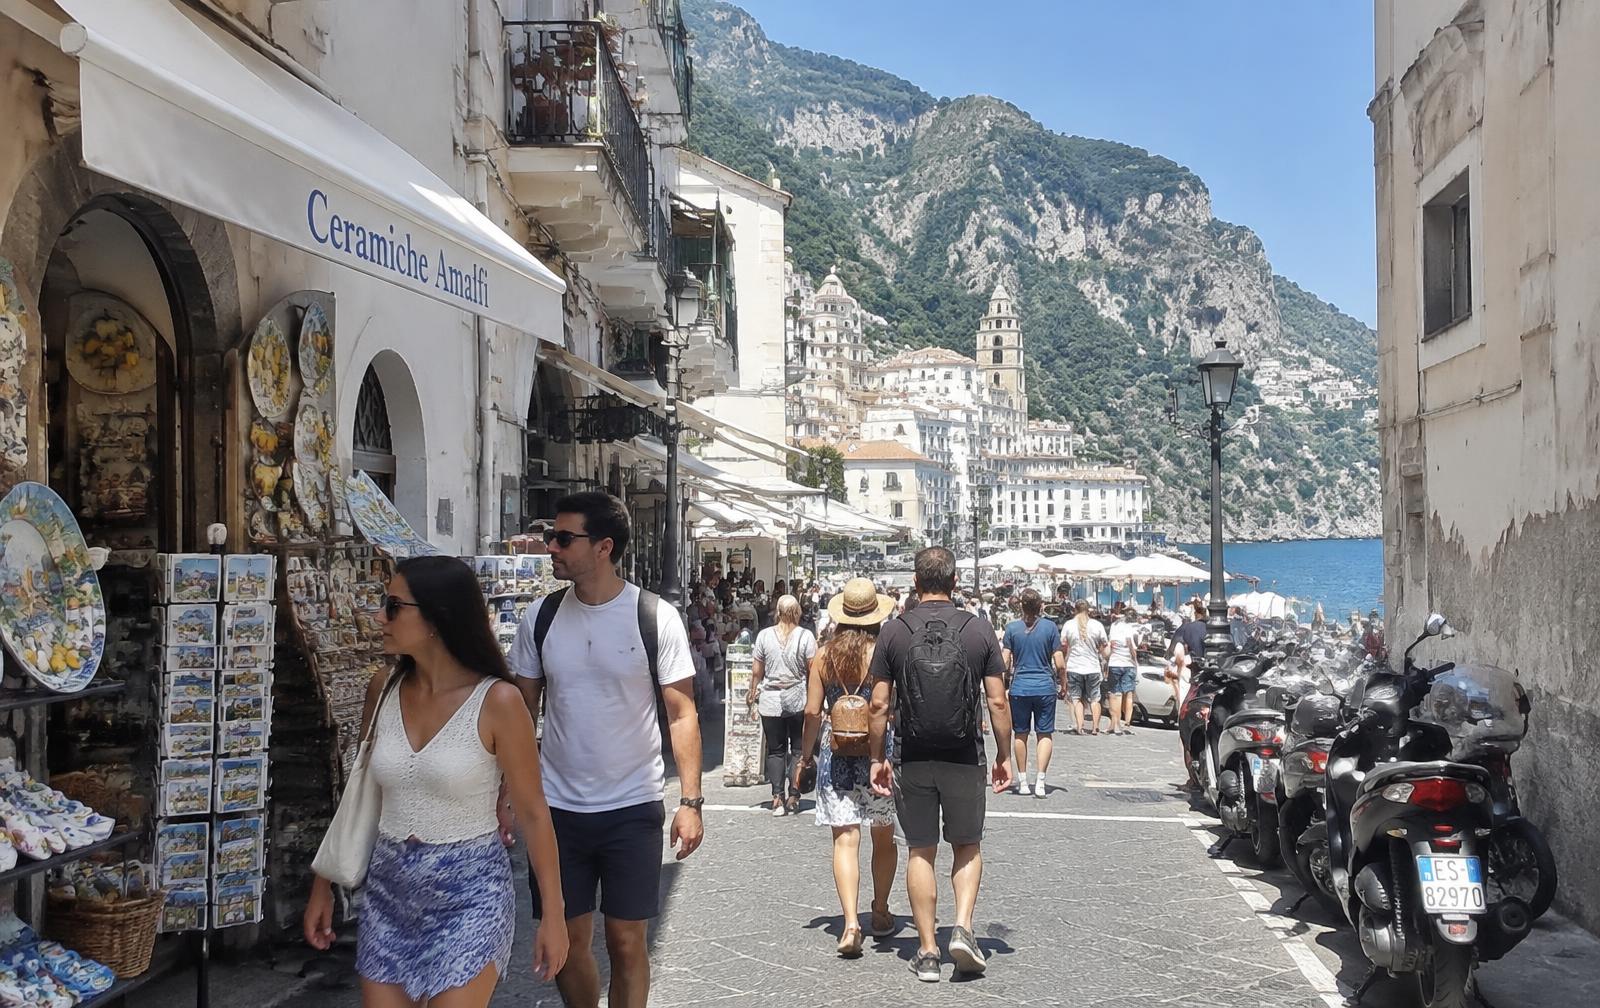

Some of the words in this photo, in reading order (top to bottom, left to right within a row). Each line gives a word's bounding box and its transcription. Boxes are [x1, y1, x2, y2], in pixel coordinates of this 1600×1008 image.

[308, 189, 429, 283] Ceramiche
[435, 249, 488, 308] Amalfi
[1425, 886, 1482, 907] 82970
